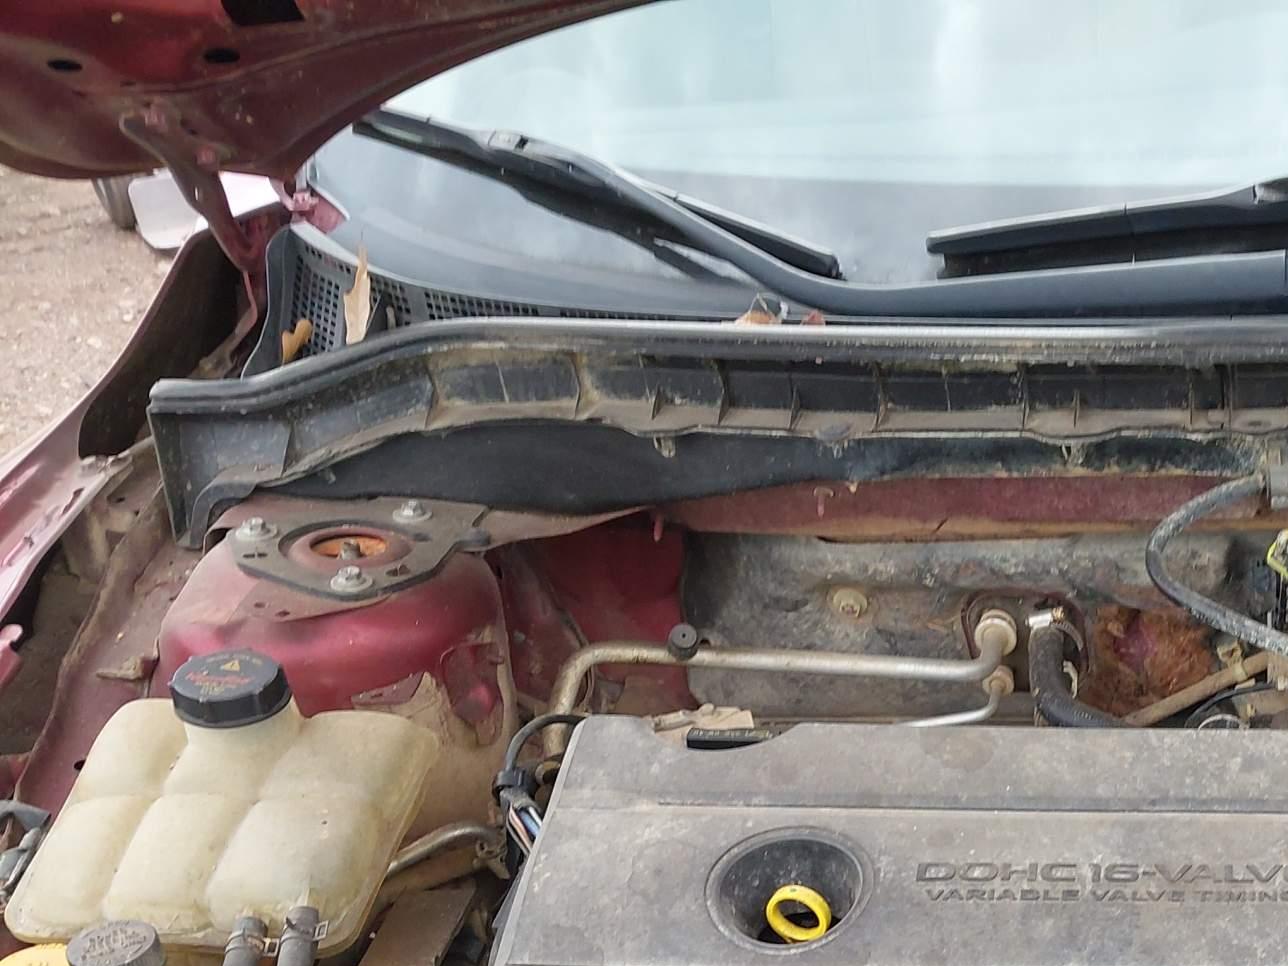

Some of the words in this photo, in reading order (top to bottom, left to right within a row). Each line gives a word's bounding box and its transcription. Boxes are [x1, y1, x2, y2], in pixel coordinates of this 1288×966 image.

[915, 862, 1078, 882] DOHC
[925, 888, 1081, 902] VARIABLE
[1091, 888, 1186, 902] VALVE
